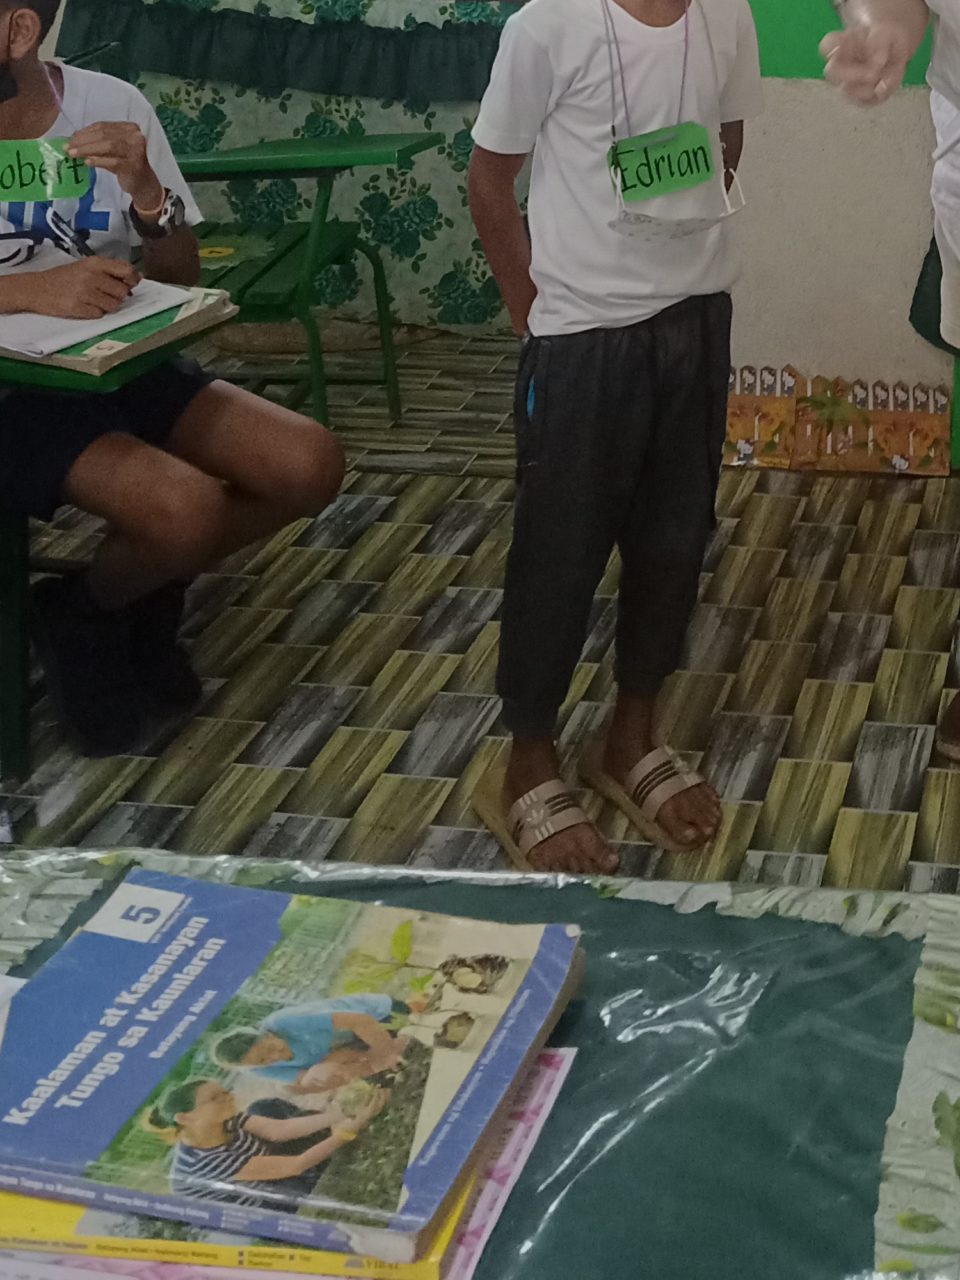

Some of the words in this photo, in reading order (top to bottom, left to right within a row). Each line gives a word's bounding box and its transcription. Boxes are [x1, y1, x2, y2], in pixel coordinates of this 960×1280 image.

[0, 150, 86, 191] obert
[613, 144, 710, 193] Edrian
[120, 904, 161, 925] 5
[4, 1031, 107, 1126] Kaalaman
[99, 1007, 129, 1028] at
[115, 916, 210, 1005] Kasanayan
[54, 1052, 125, 1108] Tungo
[117, 1025, 149, 1049] sa
[135, 937, 227, 1022] Kaunlaran
